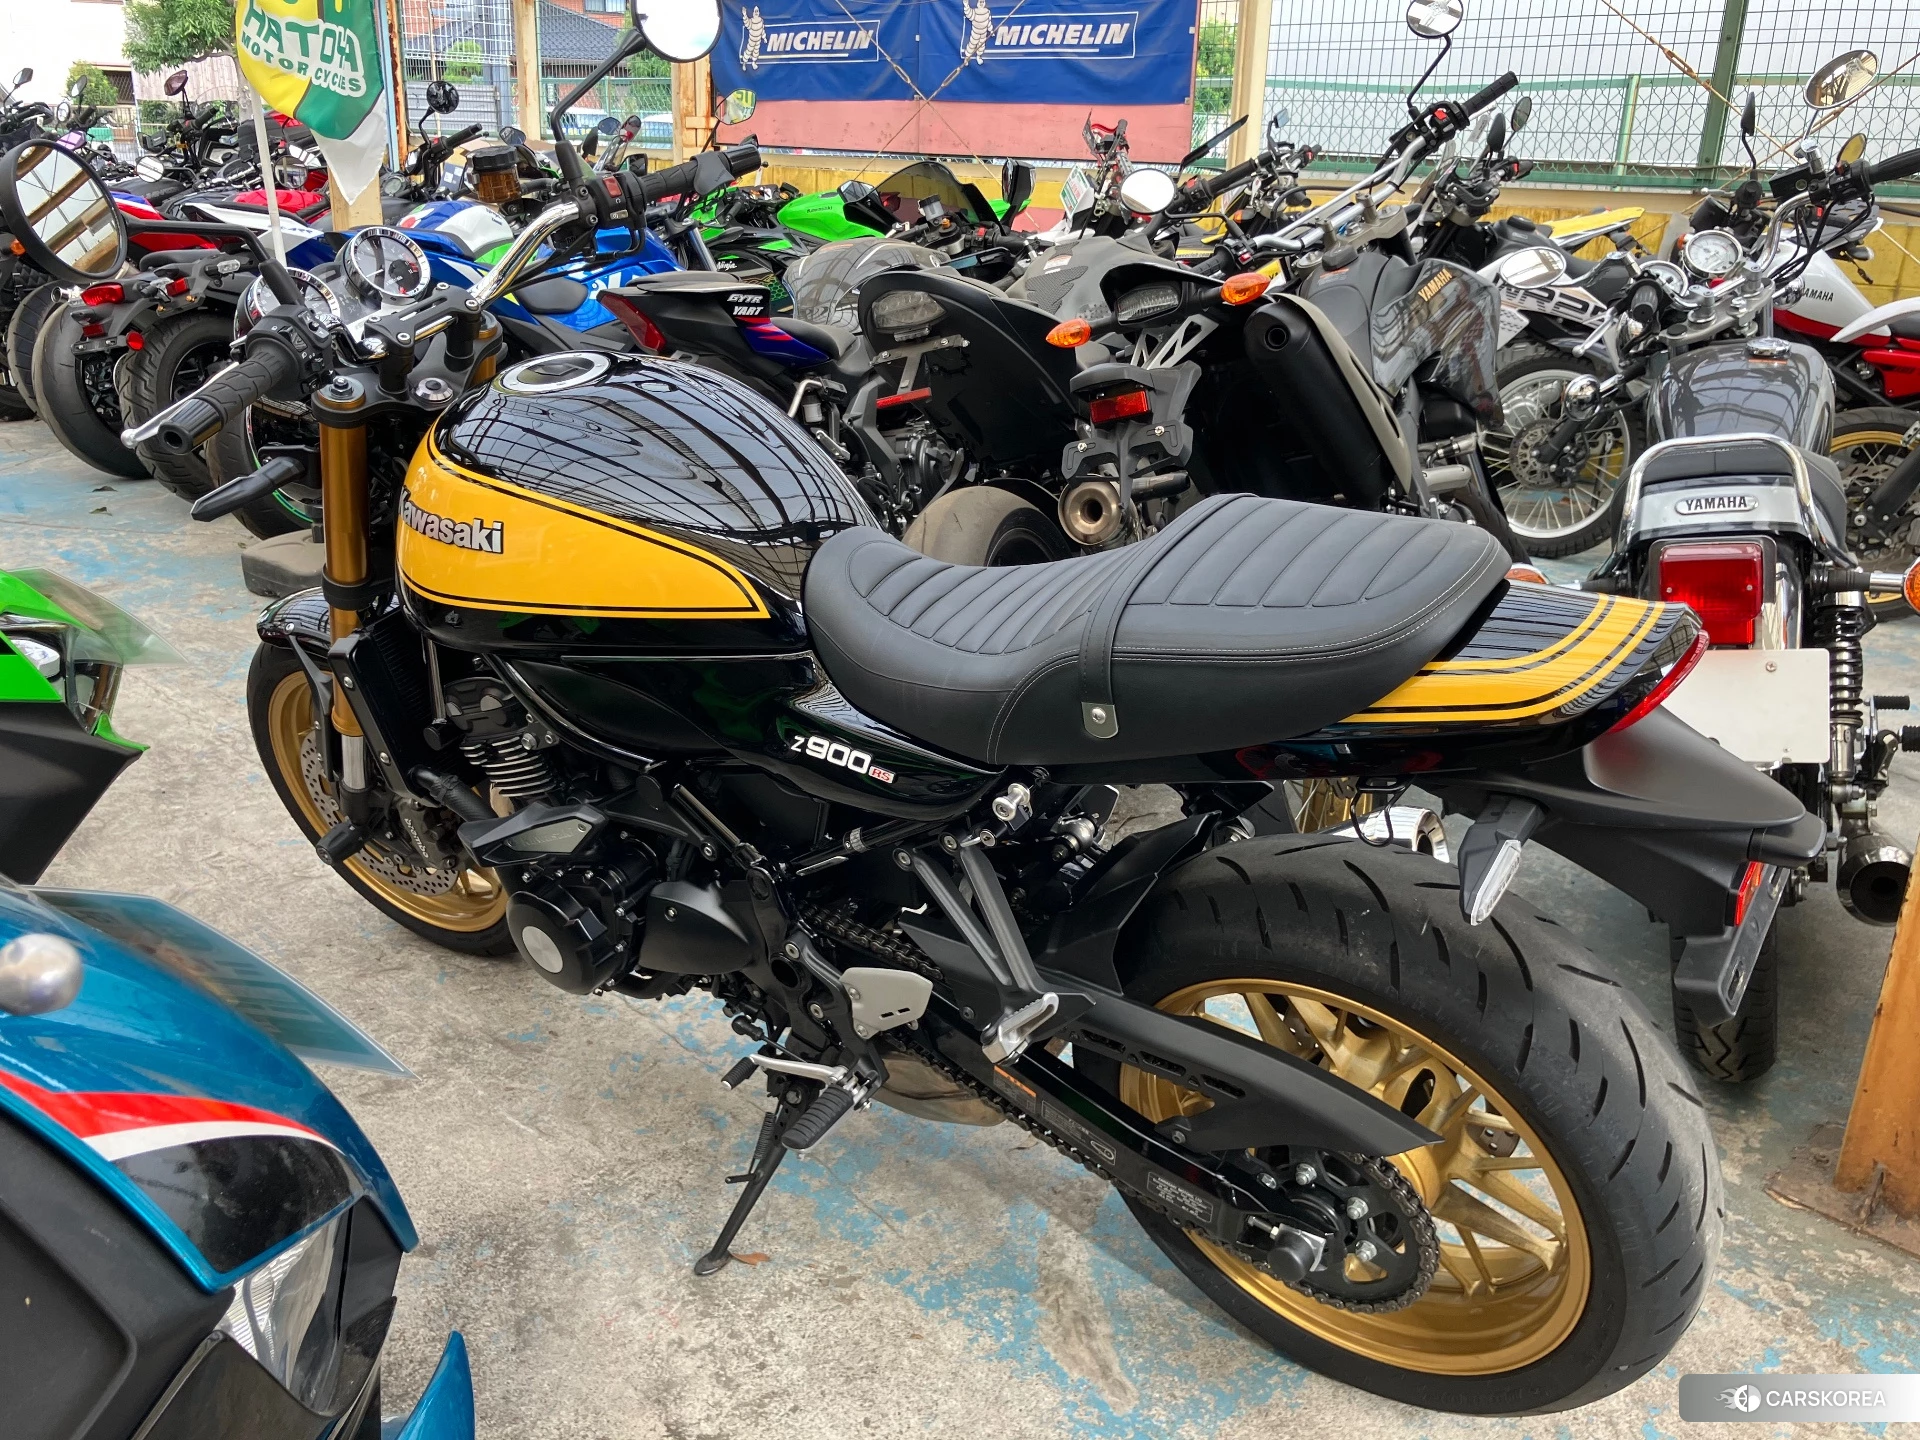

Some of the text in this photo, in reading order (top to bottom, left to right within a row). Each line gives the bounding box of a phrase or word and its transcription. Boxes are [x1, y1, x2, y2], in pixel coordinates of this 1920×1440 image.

[244, 0, 359, 73] HATOYA
[766, 30, 874, 52] MICHELIN
[995, 22, 1131, 46] MICHELIN
[241, 30, 309, 77] MOTOR
[1417, 268, 1453, 302] YAMAHA
[1800, 286, 1834, 302] AMAHA
[727, 293, 764, 304] GYTR
[733, 306, 764, 316] YART
[1685, 496, 1748, 511] YAMAHA
[400, 485, 504, 554] Kawasaki
[404, 818, 429, 859] brembo
